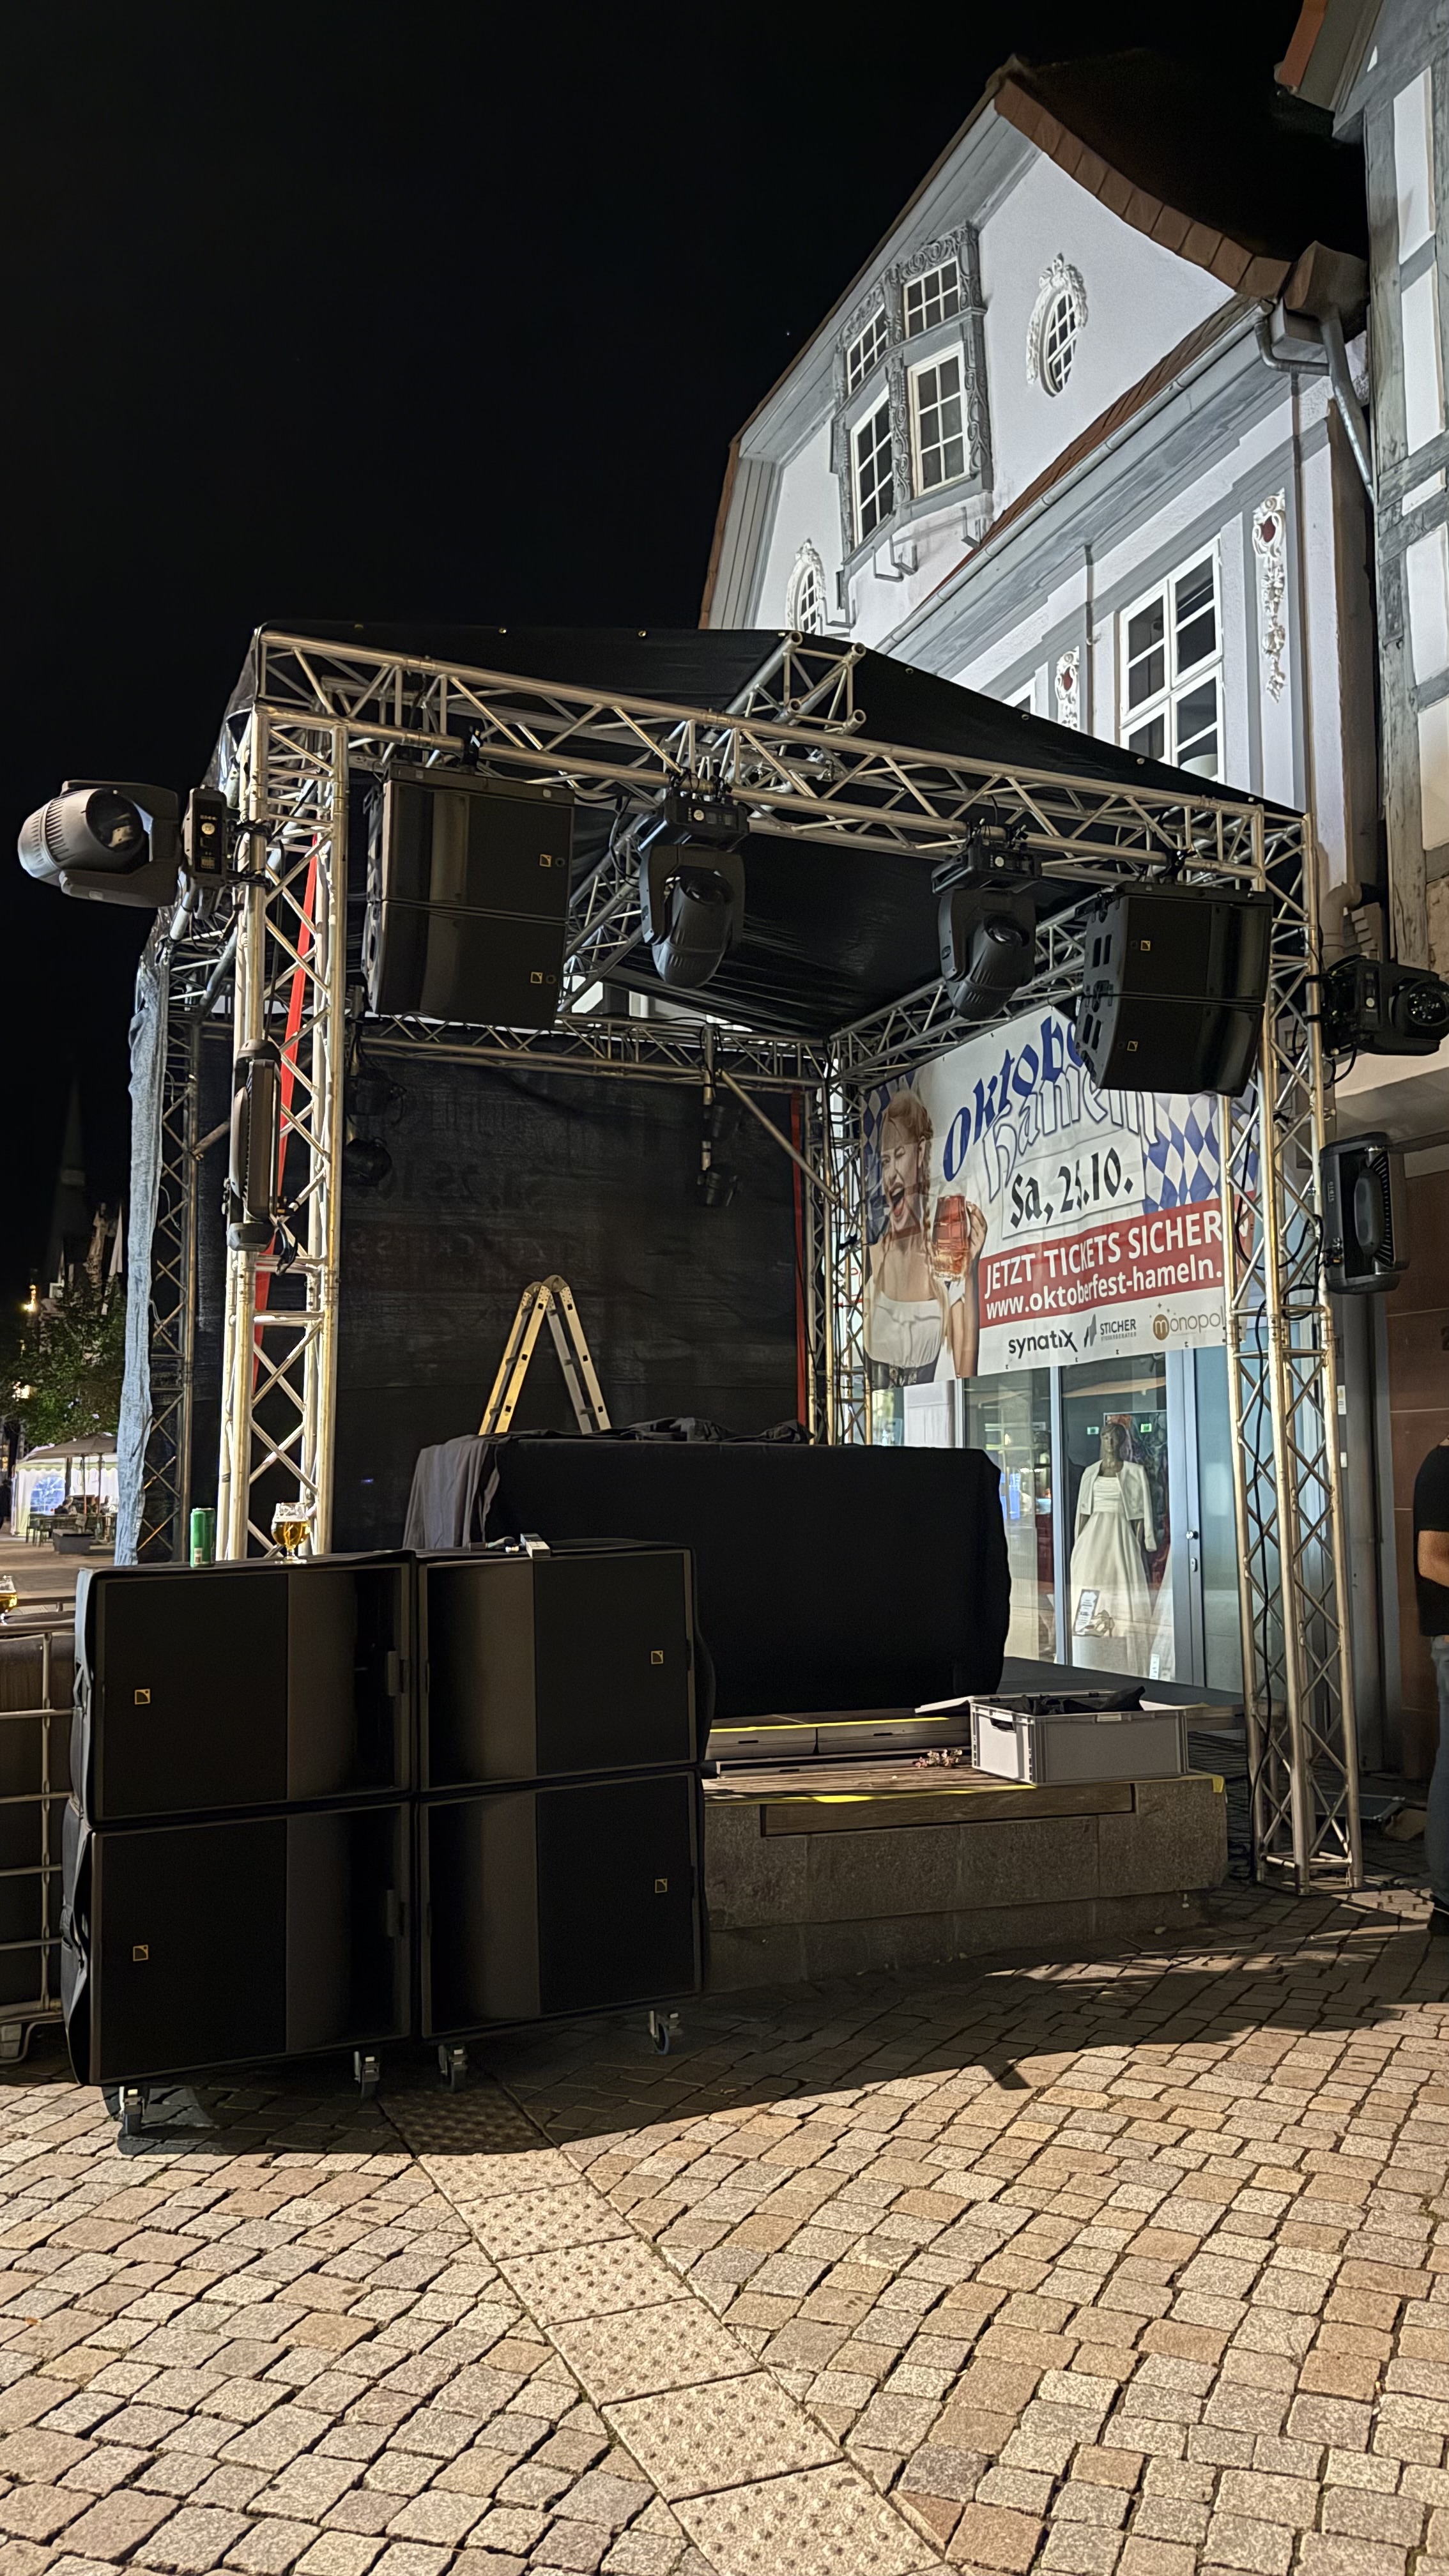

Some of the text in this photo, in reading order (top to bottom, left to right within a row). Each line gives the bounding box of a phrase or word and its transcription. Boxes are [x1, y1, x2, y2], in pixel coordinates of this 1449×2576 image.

[1011, 1173, 1054, 1227] Sa,
[985, 1254, 1034, 1299] JETZT
[1044, 1232, 1121, 1278] TICKETS
[1100, 1319, 1137, 1335] STICHER
[1153, 1305, 1225, 1340] monopol
